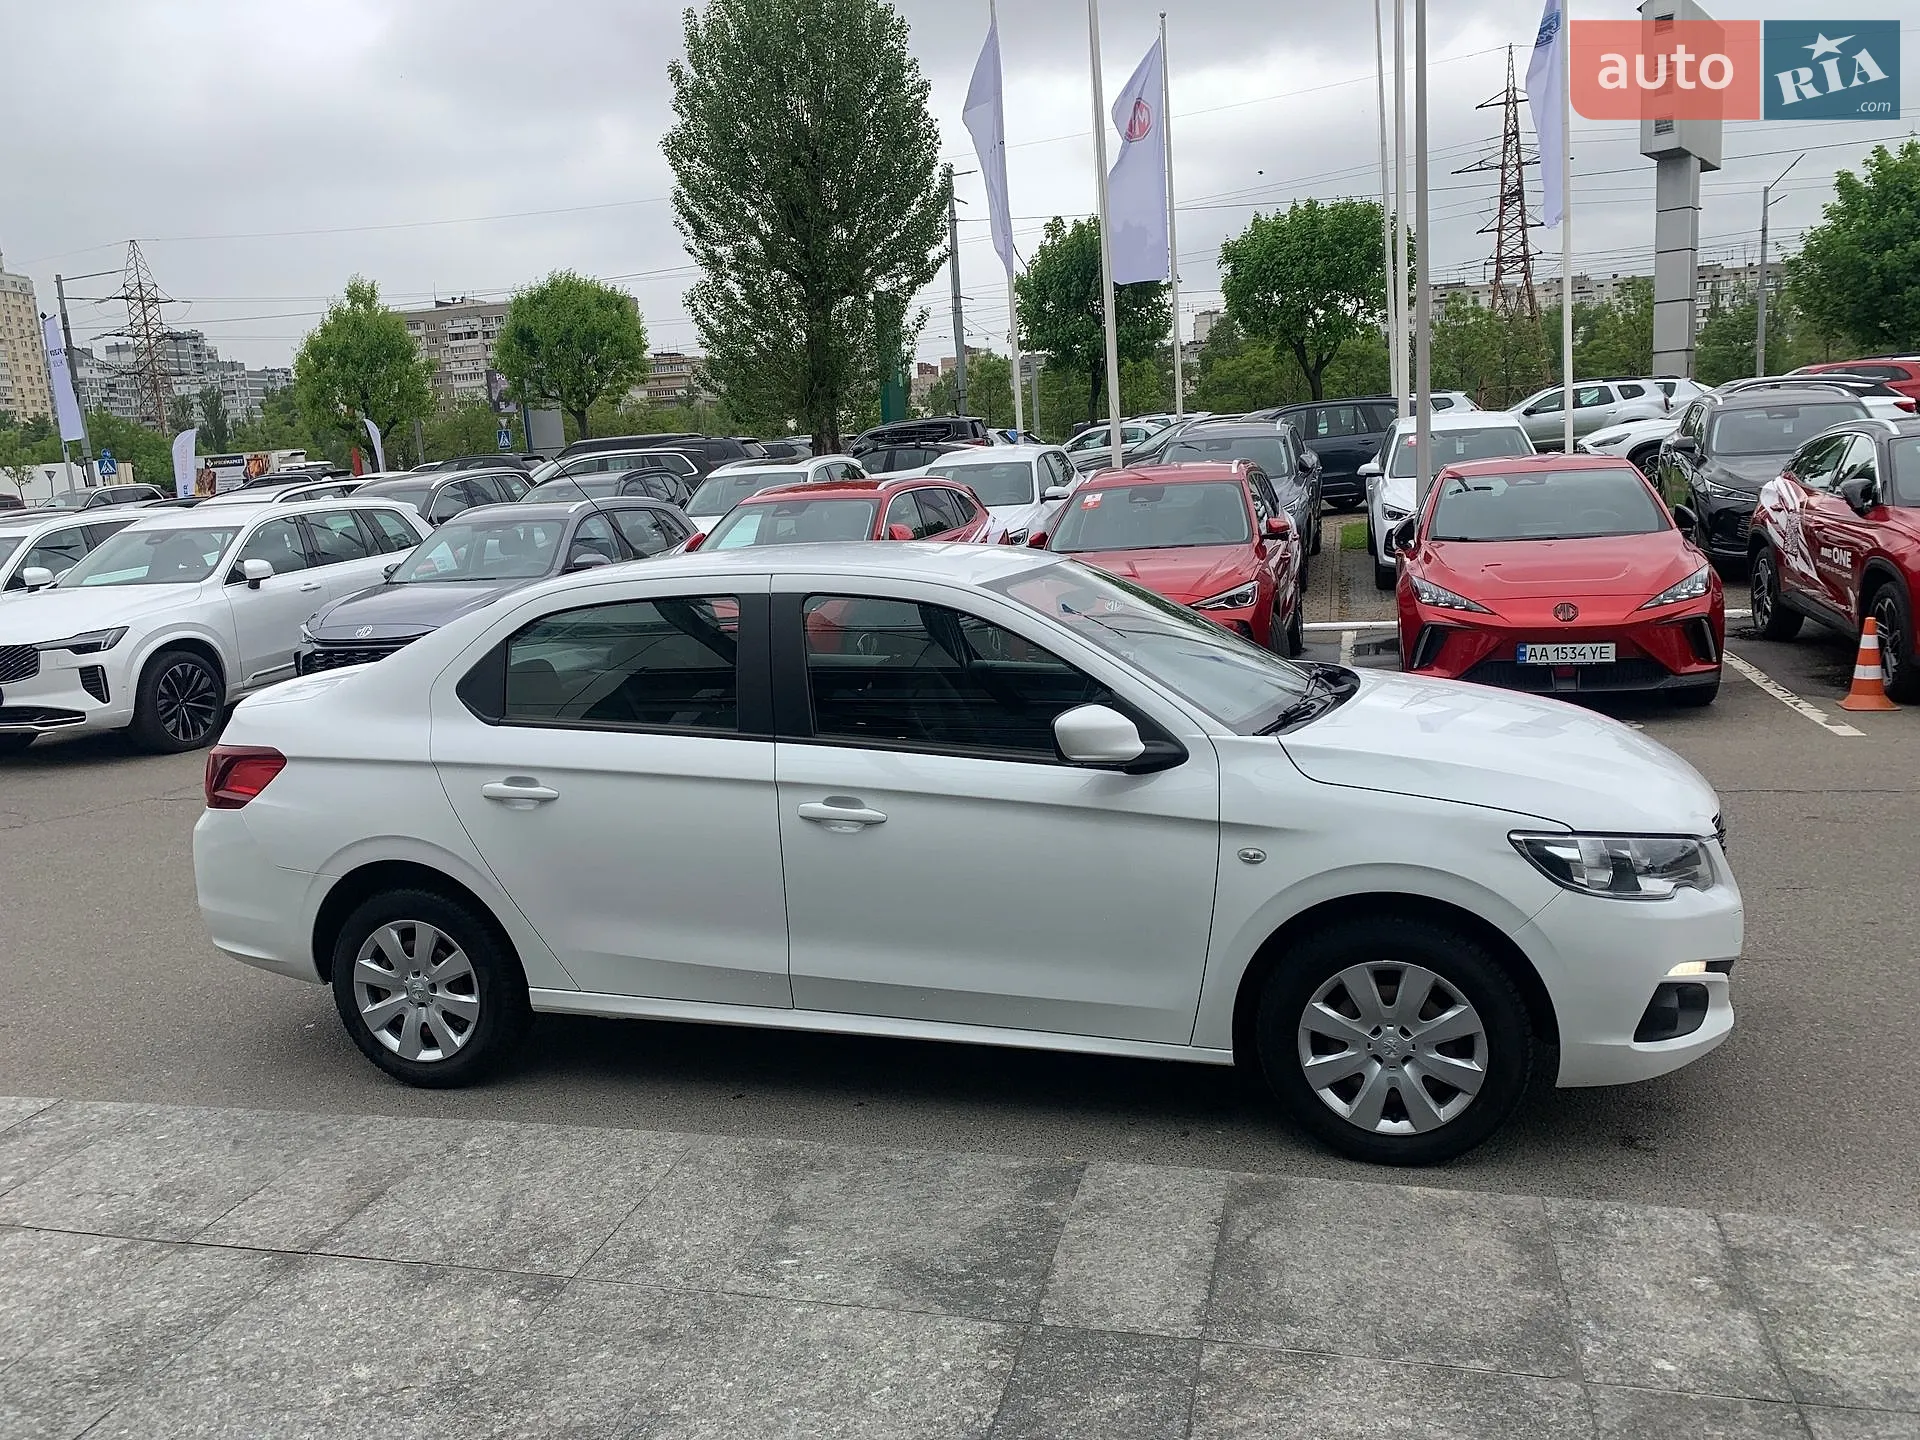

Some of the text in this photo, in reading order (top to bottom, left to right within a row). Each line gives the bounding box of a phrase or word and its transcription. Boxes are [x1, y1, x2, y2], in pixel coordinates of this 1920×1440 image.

[1832, 547, 1852, 568] ONE
[1528, 647, 1549, 660] AA
[1553, 646, 1586, 660] 1534
[1590, 646, 1610, 659] YE
